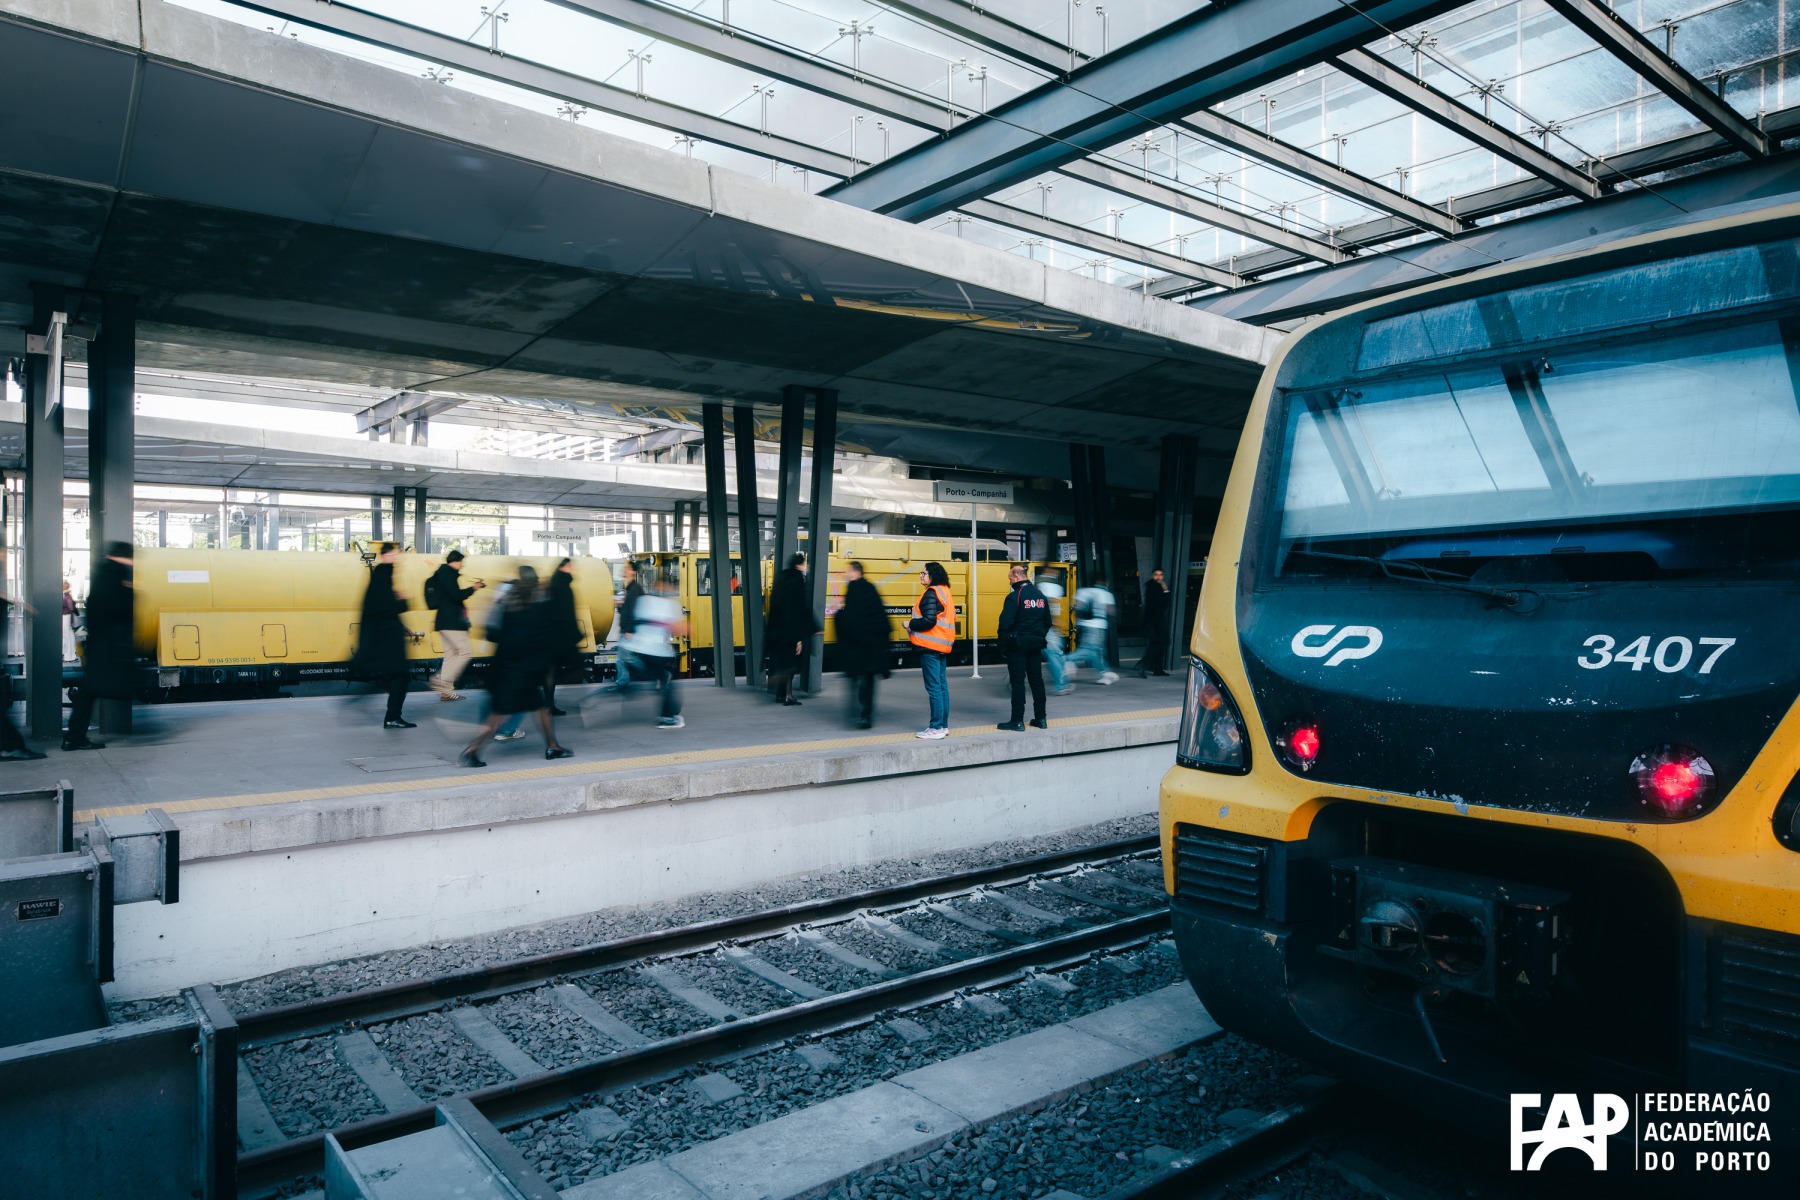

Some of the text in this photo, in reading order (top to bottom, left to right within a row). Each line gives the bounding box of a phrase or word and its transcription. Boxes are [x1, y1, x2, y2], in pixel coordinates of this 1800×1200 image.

[945, 487, 966, 496] Porto
[971, 488, 1007, 498] Campanhã
[1577, 634, 1736, 674] 3407
[22, 901, 56, 909] RAWIE
